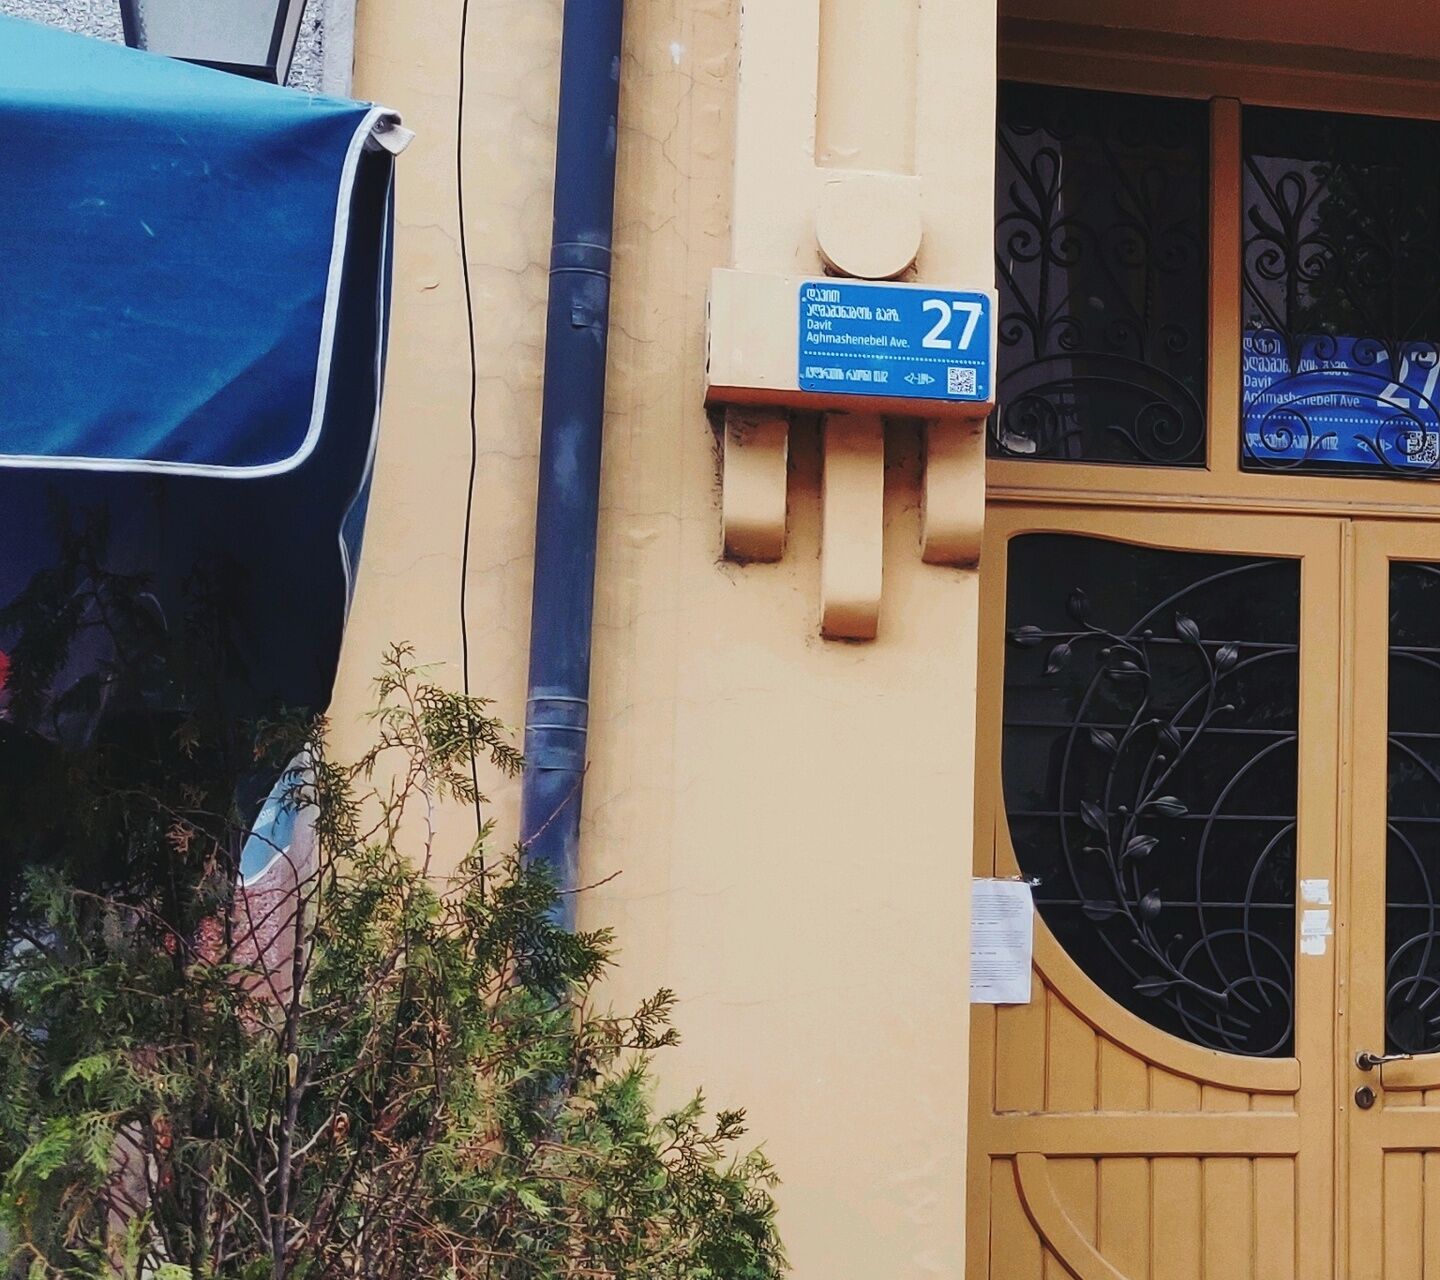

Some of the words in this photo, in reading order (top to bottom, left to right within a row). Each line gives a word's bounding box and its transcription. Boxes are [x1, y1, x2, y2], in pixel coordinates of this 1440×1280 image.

[807, 319, 832, 331] Davit
[921, 298, 982, 350] 27
[806, 332, 888, 347] Aghmashenebeli
[890, 334, 910, 348] Ave.
[1244, 375, 1272, 388] Davit
